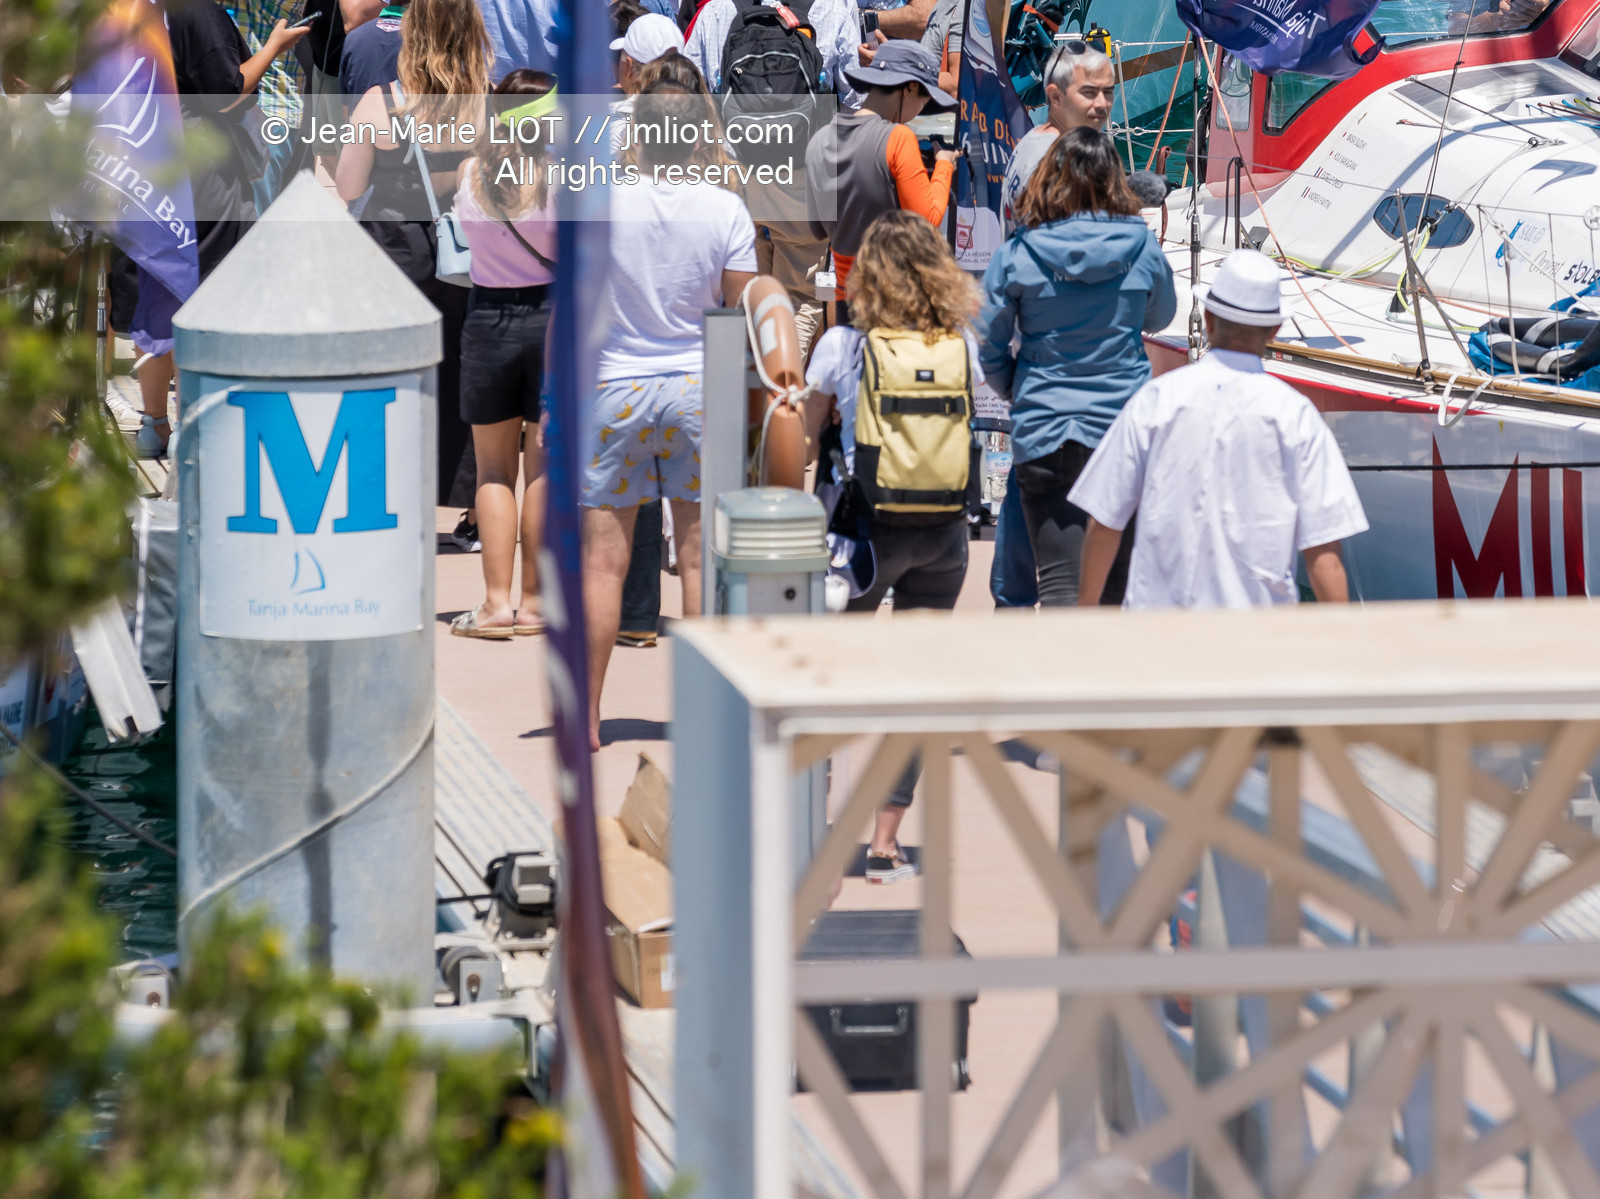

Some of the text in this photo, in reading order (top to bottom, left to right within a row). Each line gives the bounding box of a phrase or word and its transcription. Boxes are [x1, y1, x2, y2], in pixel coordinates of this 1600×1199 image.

[155, 194, 197, 250] Bay
[226, 387, 397, 535] M
[247, 598, 382, 620] Tanja Marina Bay
